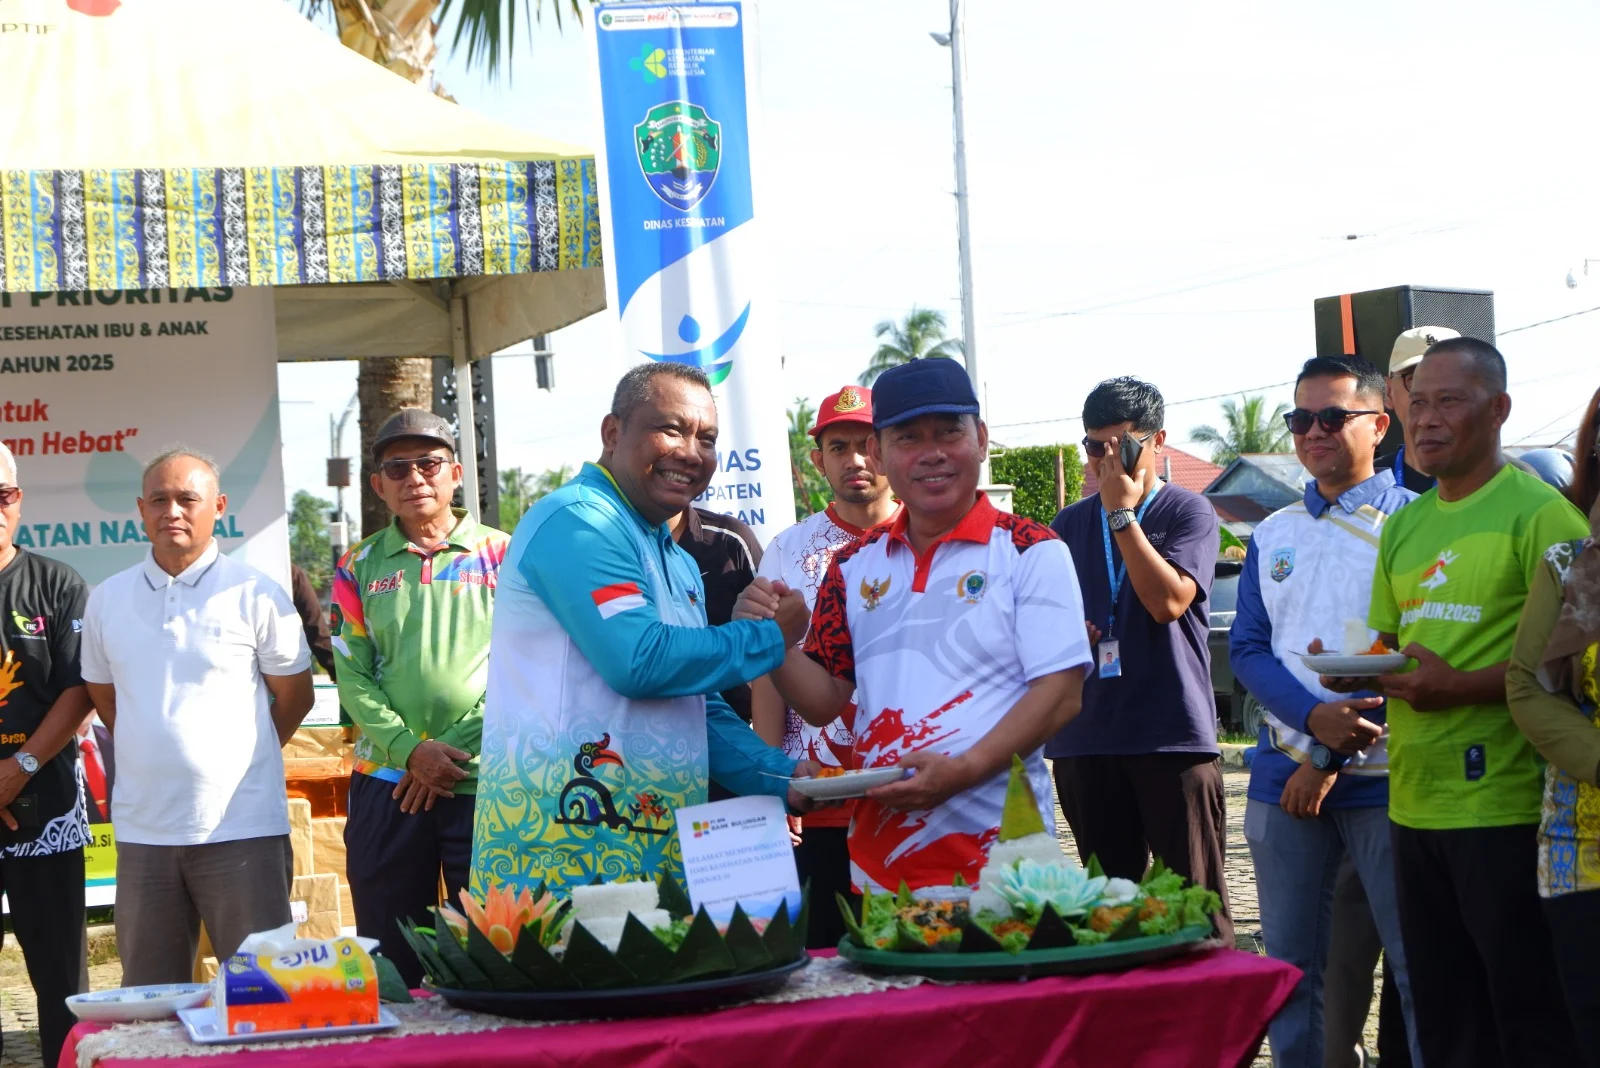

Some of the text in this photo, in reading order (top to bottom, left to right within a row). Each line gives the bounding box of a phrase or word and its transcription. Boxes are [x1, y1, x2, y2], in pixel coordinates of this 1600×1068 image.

[643, 219, 673, 230] DINAS
[104, 323, 134, 338] IBU
[140, 322, 152, 337] &
[157, 320, 209, 336] ANAK
[0, 354, 115, 374] AHUN 2025
[0, 398, 49, 422] tuk
[13, 521, 91, 548] ATAN
